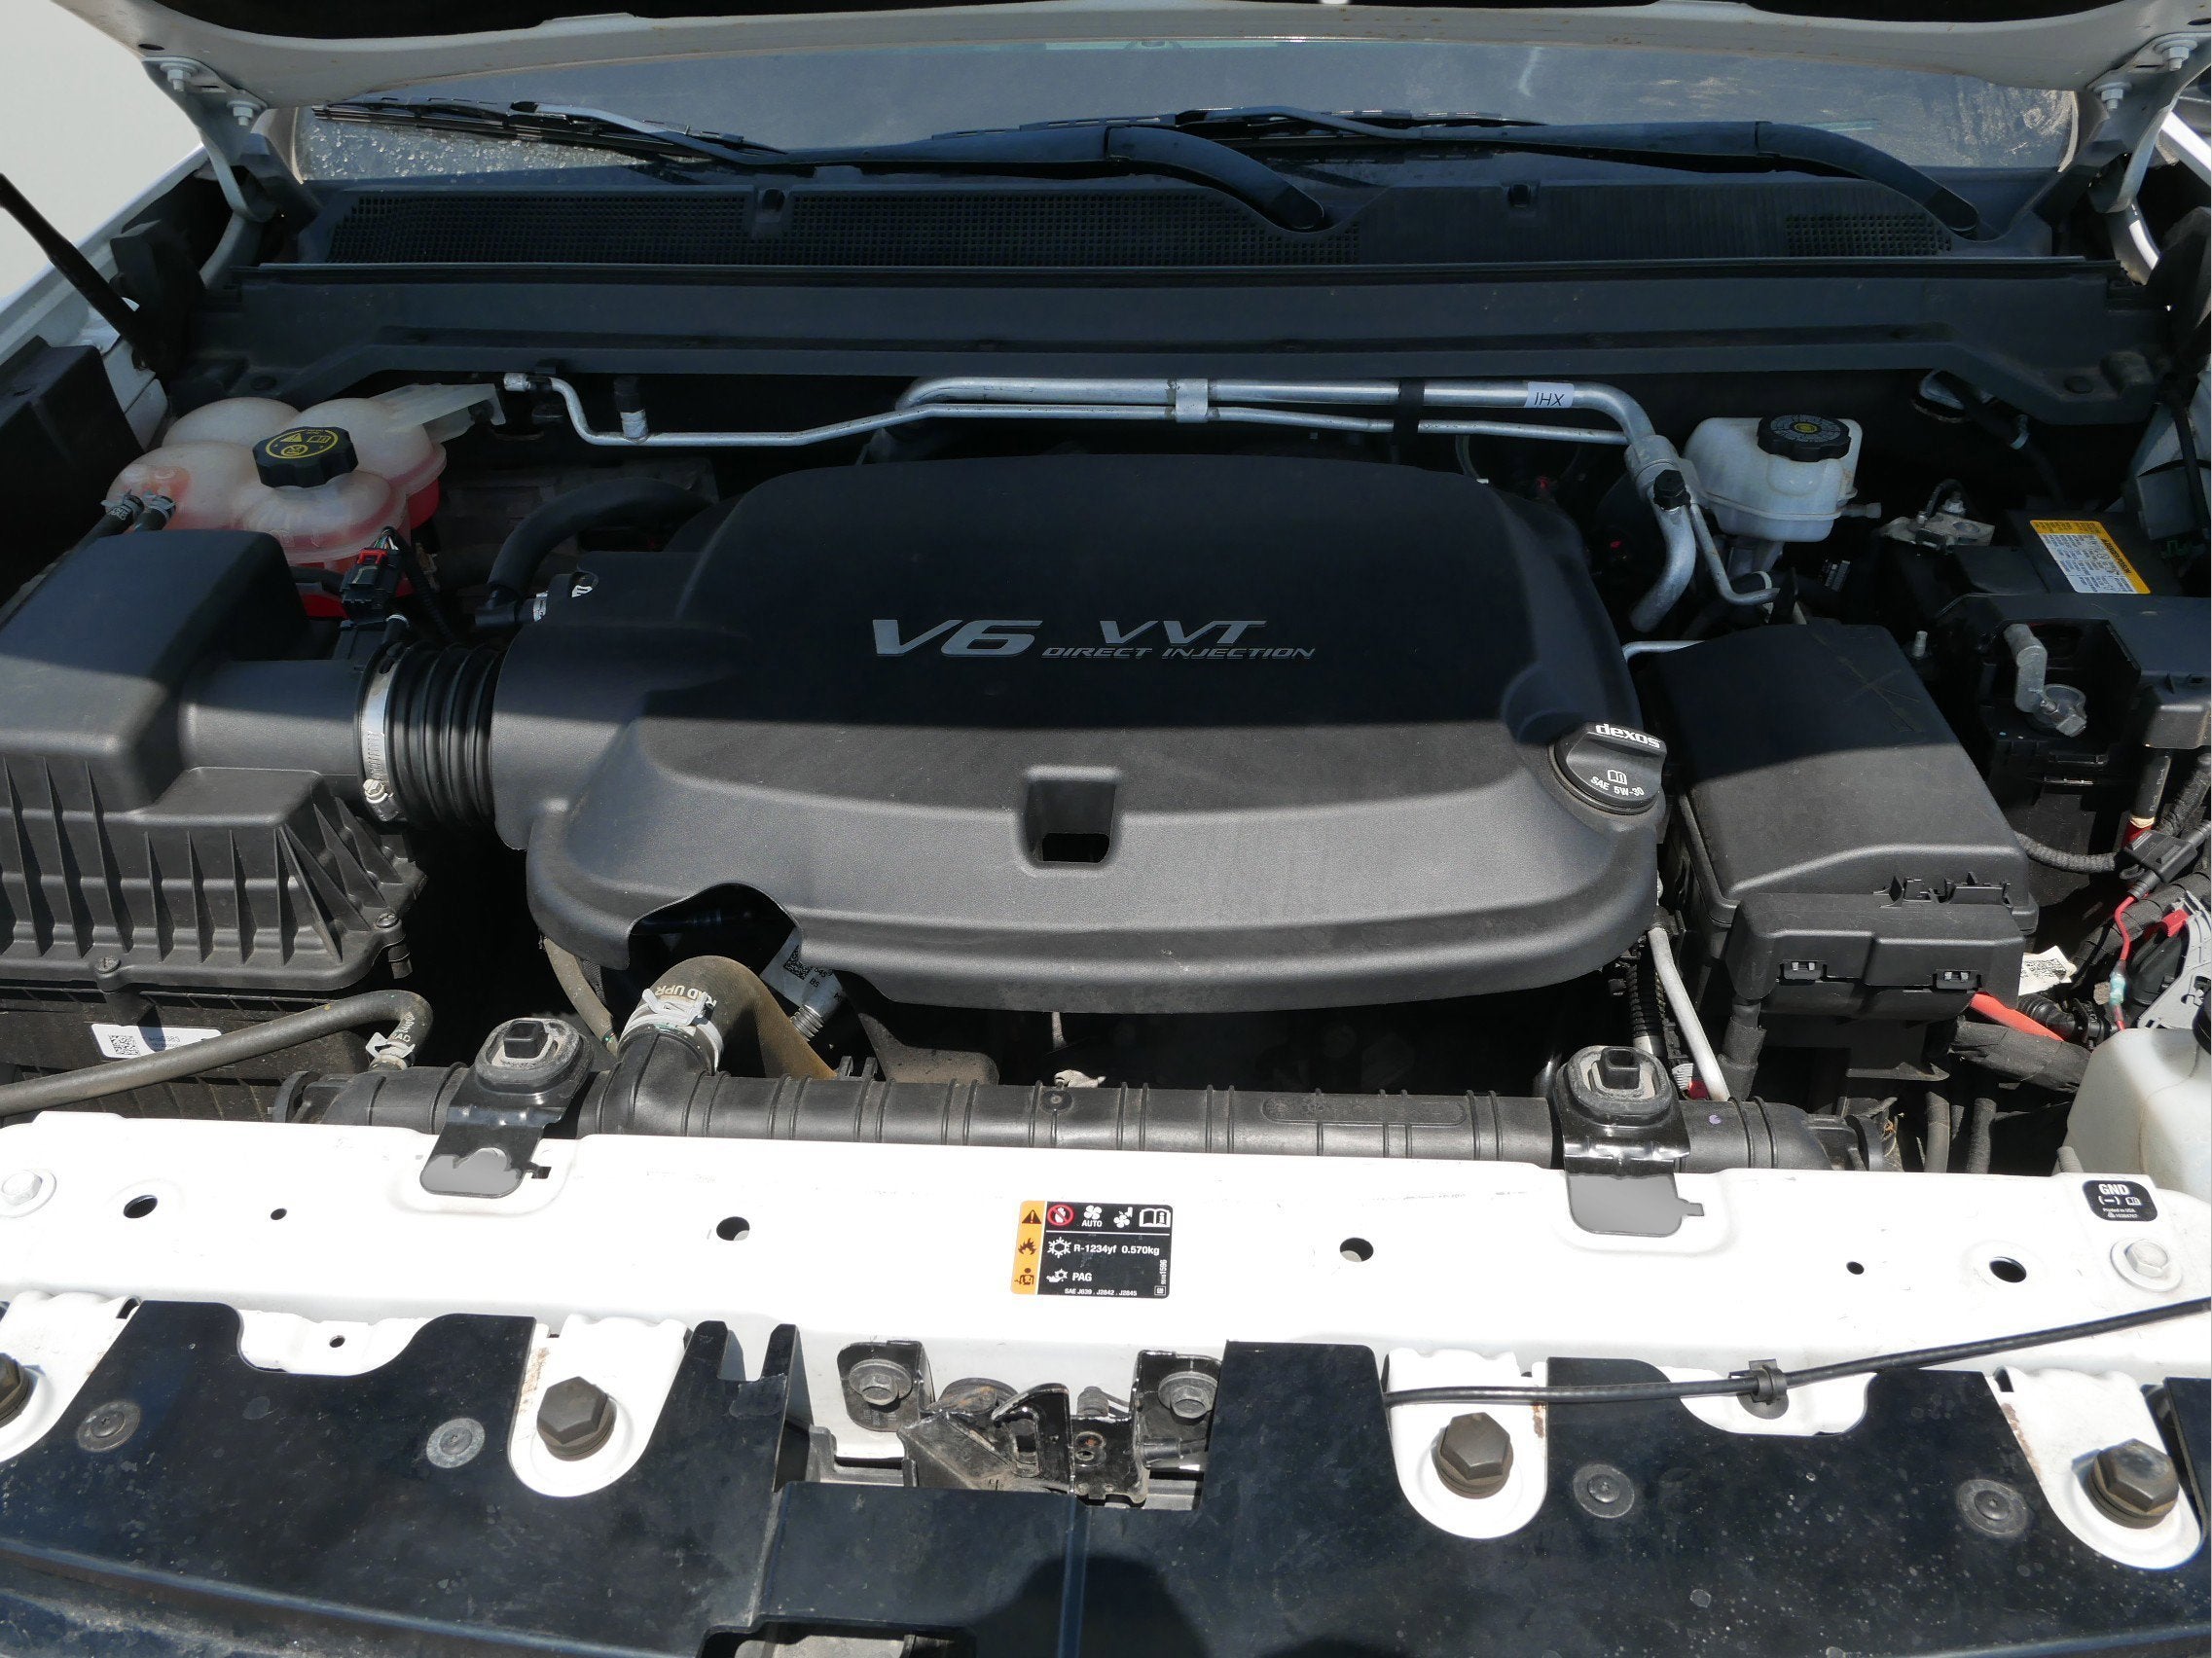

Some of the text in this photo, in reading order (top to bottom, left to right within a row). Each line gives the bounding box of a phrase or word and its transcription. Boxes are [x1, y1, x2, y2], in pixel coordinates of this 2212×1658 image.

[872, 619, 1044, 659] V6
[1098, 619, 1267, 646] VVT
[1041, 646, 1316, 661] DIRECT INJECTION
[1595, 723, 1661, 749] dexos
[1590, 775, 1645, 797] SAE 5W-30
[654, 984, 686, 996] UPR
[2098, 1183, 2130, 1195] GND
[1073, 1244, 1160, 1256] R-1234yf 0.570kg
[1071, 1272, 1093, 1281] PAG
